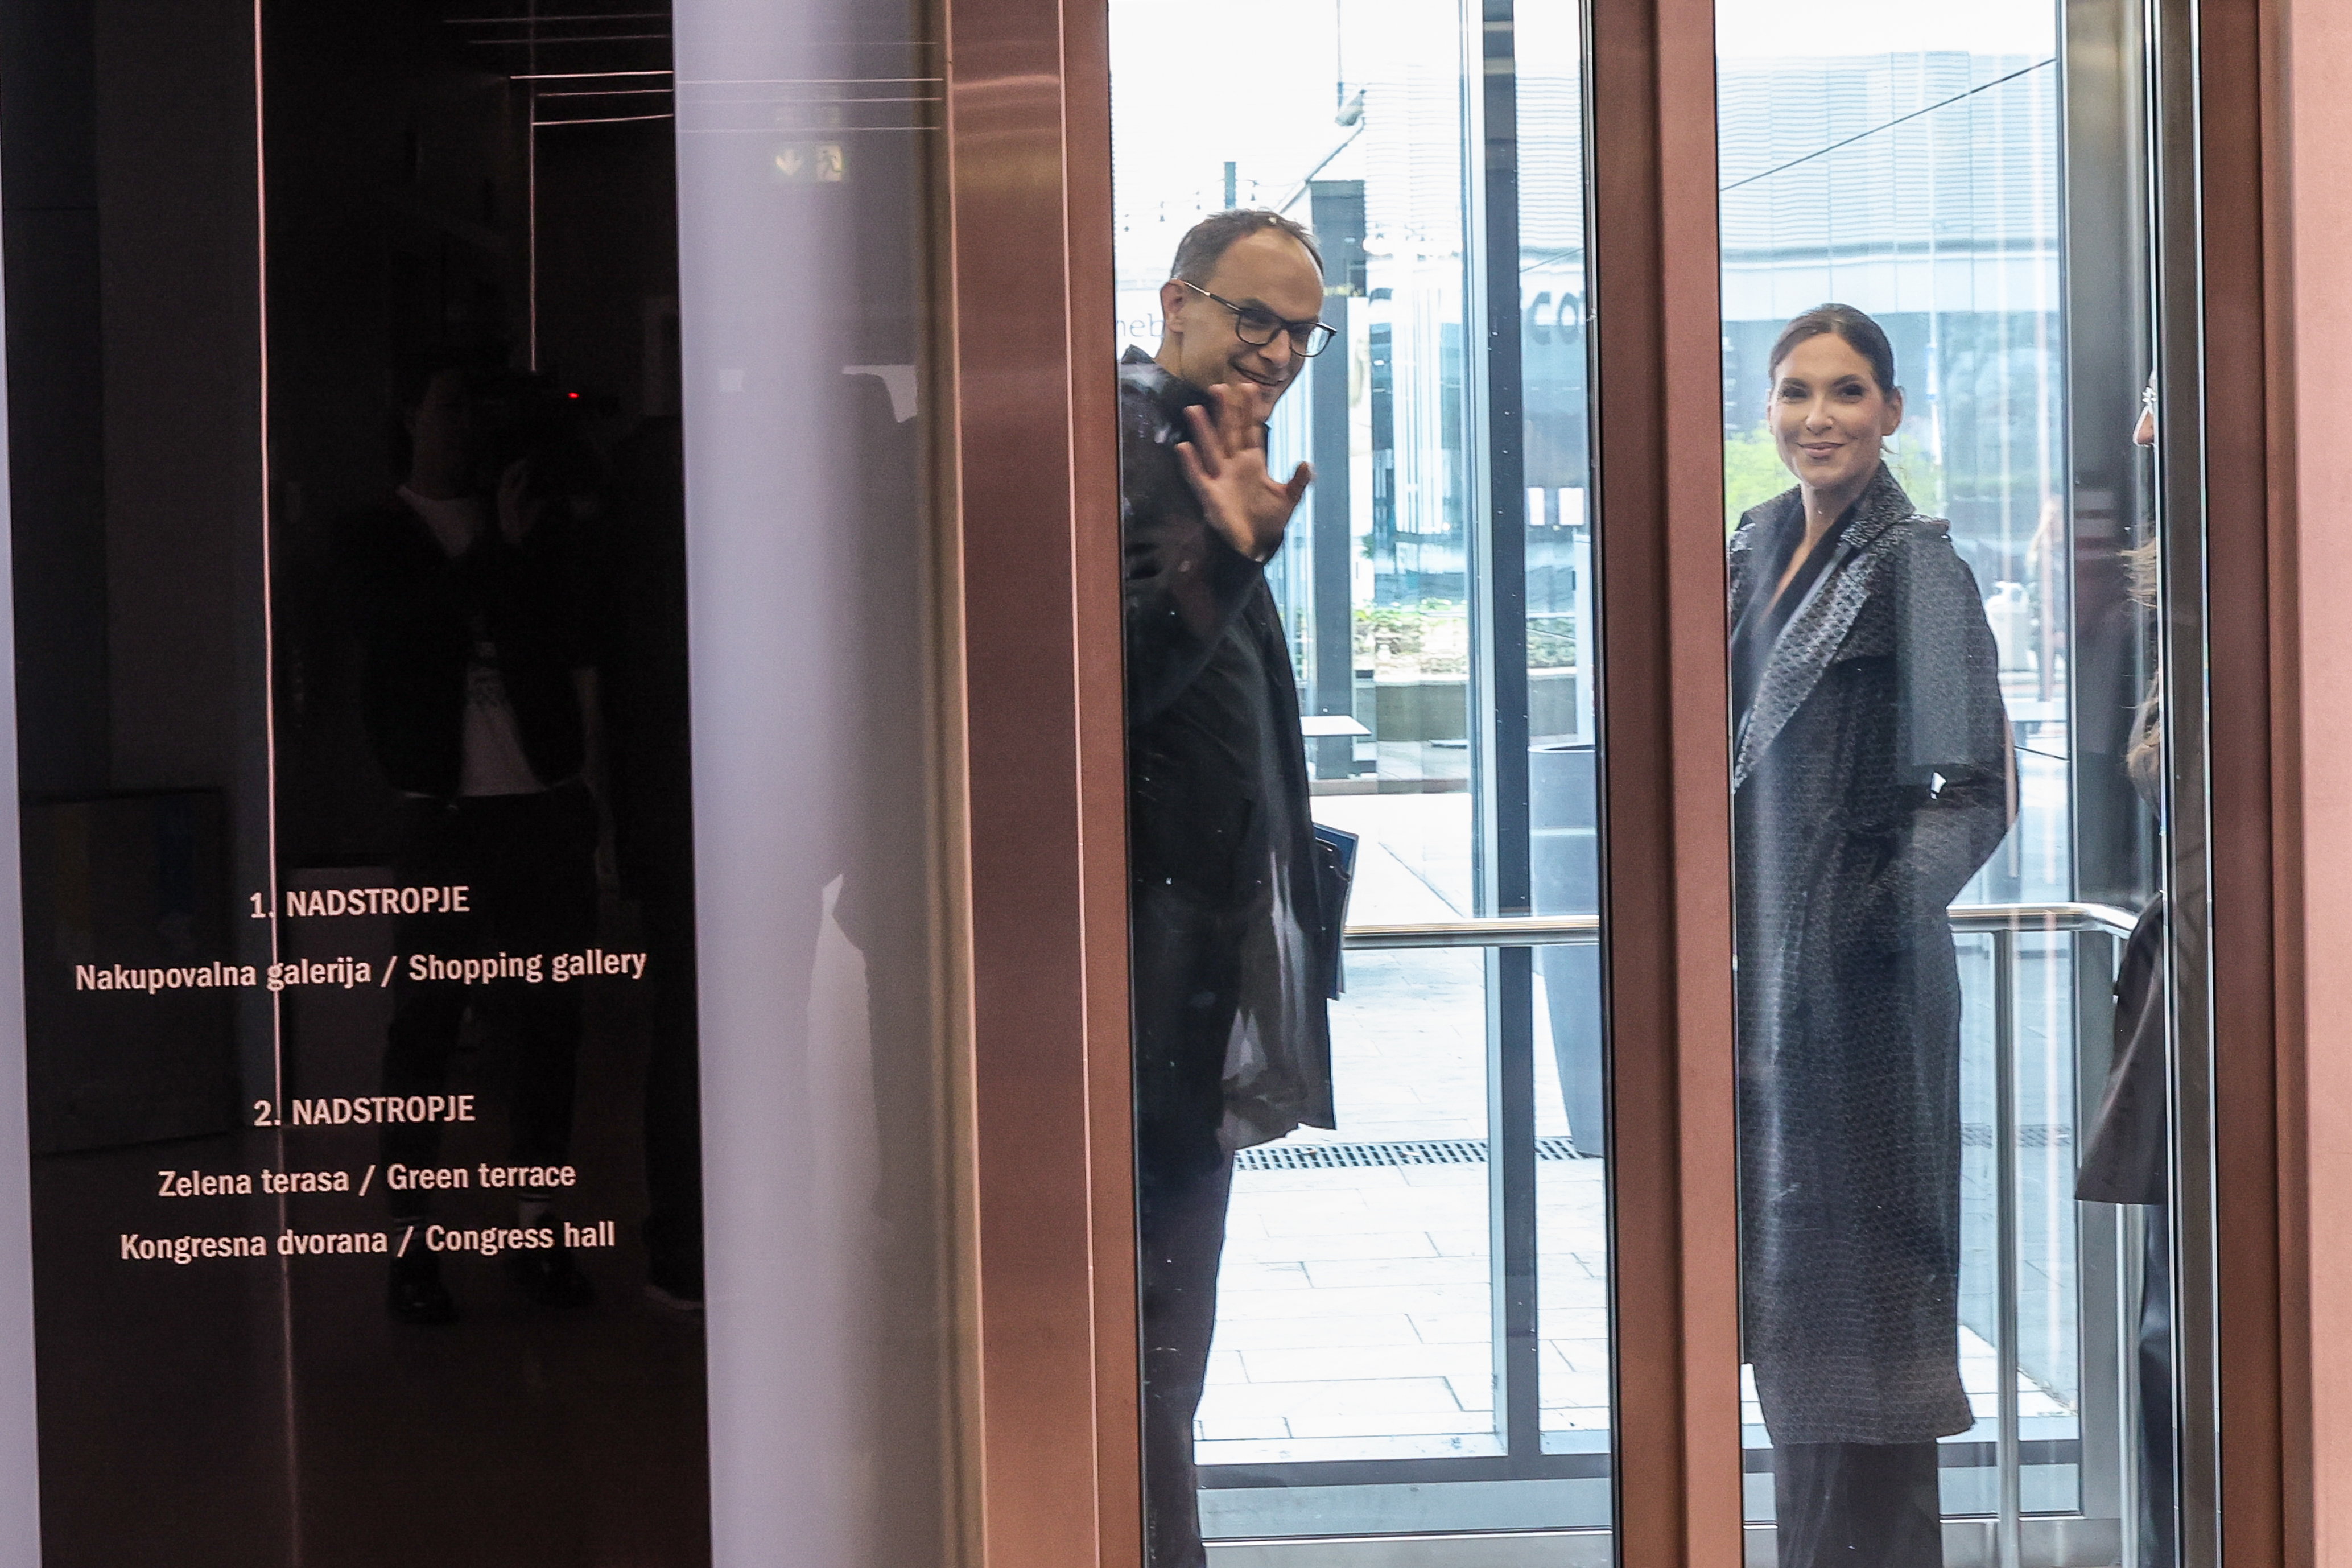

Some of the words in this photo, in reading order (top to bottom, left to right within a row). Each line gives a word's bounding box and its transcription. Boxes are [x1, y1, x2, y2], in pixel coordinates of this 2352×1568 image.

[250, 892, 275, 918] 1.
[287, 886, 470, 917] NADSTROPJE
[76, 961, 257, 995] Nakupovalna
[266, 956, 371, 992] galerija
[380, 955, 397, 987] /
[409, 951, 543, 985] Shopping
[552, 949, 646, 982] gallery
[254, 1099, 281, 1127] 2.
[292, 1095, 475, 1125] NADSTROPJE
[158, 1170, 252, 1197] Zelena
[261, 1169, 349, 1194] terasa
[358, 1165, 376, 1196] /
[387, 1164, 468, 1190] Green
[478, 1163, 576, 1188] terrace
[121, 1234, 267, 1264] Kongresna
[277, 1229, 387, 1255] dvorana
[397, 1225, 414, 1257] /
[426, 1225, 554, 1256] Congress
[564, 1220, 614, 1247] hall
